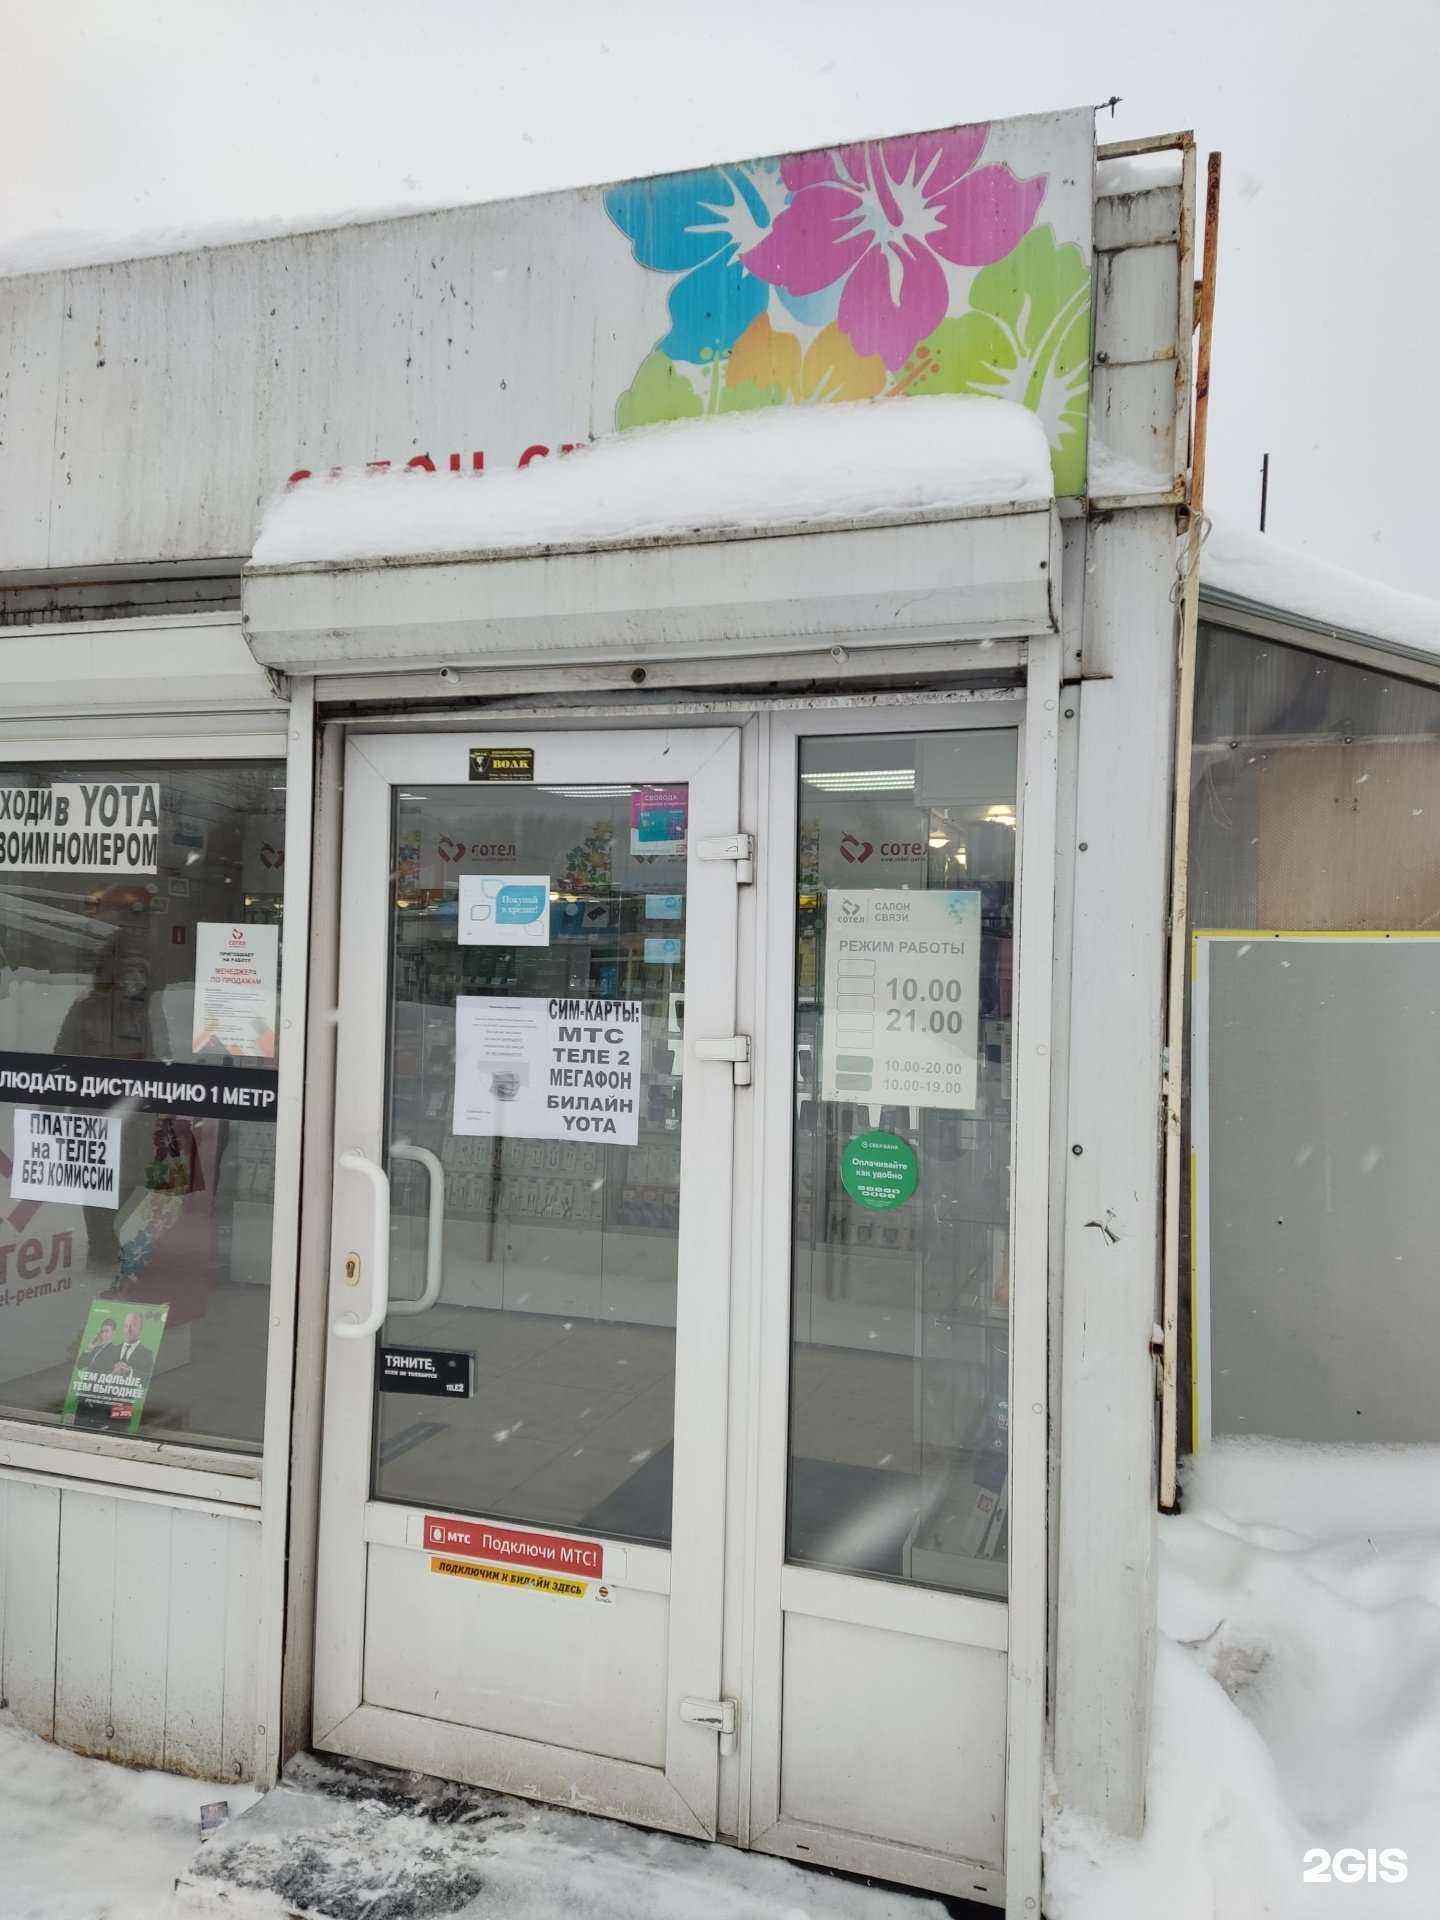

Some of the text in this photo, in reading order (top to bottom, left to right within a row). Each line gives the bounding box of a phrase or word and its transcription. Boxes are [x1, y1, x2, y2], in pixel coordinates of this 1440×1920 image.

[80, 785, 158, 827] YOTA
[52, 832, 157, 866] НОМЕРОМ
[874, 902, 911, 911] САЛОН
[874, 913, 909, 922] СВЯЗИ
[839, 940, 965, 955] РЕЖИМ РАБОТЫ
[886, 977, 962, 1003] 10.00
[548, 999, 640, 1023] СИМ-КАРТЫ:
[886, 1008, 962, 1034] 21.00
[558, 1027, 625, 1044] МТС
[553, 1048, 631, 1066] ТЕЛЕ 2
[885, 1060, 962, 1075] 10.00-20.00
[549, 1068, 632, 1090] МЕГАФОН
[885, 1079, 961, 1094] 10.00-19.00
[81, 1076, 206, 1103] ДИСТАНЦИЮ
[209, 1086, 218, 1104] 1
[223, 1086, 276, 1109] МЕТР
[547, 1095, 633, 1114] БИЛАЙН
[29, 1113, 108, 1140] ПЛАТЕЖИ
[563, 1116, 616, 1134] YOTA
[56, 1138, 107, 1164] ТЕЛЕ2
[852, 1158, 908, 1170] Оплачивайте
[21, 1160, 113, 1192] БЕЗ КОМИССИИ
[385, 1355, 435, 1373] ТЯНИТЕ,
[482, 1534, 556, 1561] Подключи
[560, 1547, 598, 1567] МТС!
[438, 1561, 499, 1580] ПОДКЛЮЧИМ
[502, 1573, 509, 1582] К
[551, 1583, 582, 1596] ЗДЕСЬ
